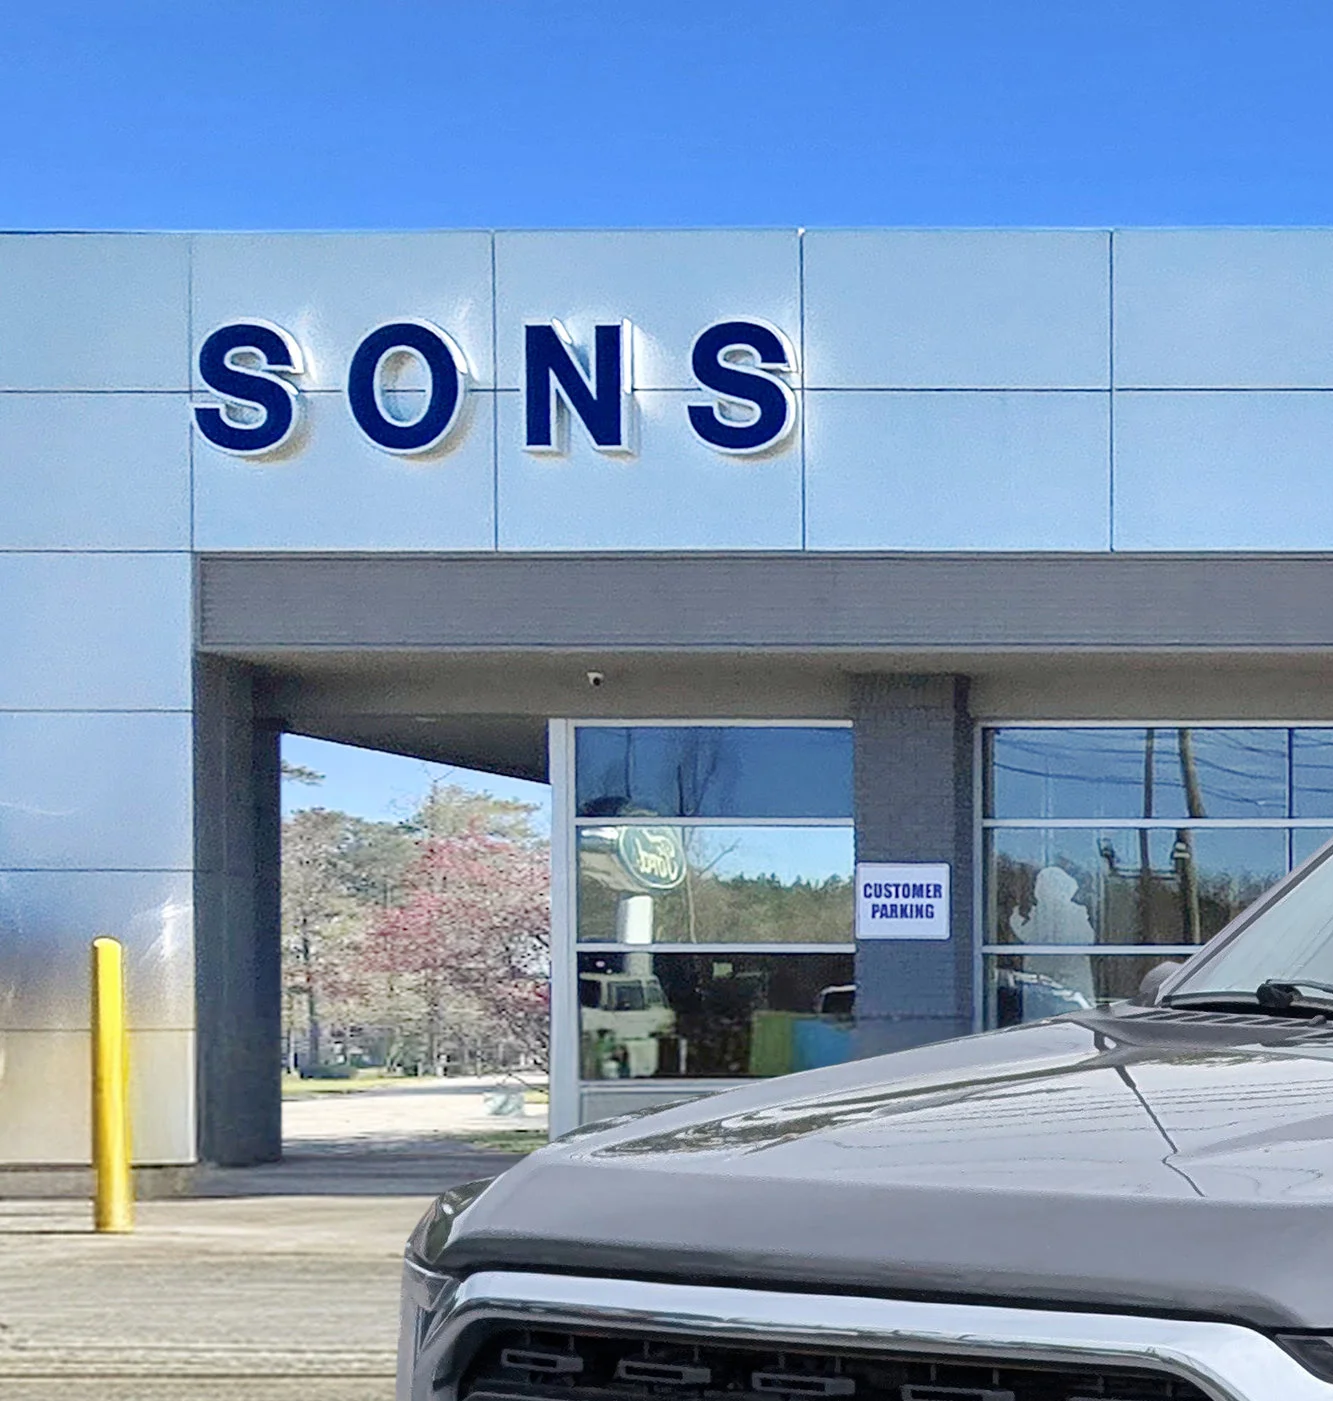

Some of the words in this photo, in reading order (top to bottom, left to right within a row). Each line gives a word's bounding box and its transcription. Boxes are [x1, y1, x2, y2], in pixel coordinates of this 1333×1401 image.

[195, 320, 797, 454] SONS
[863, 883, 942, 899] CUSTOMER
[871, 903, 934, 919] PARKING
